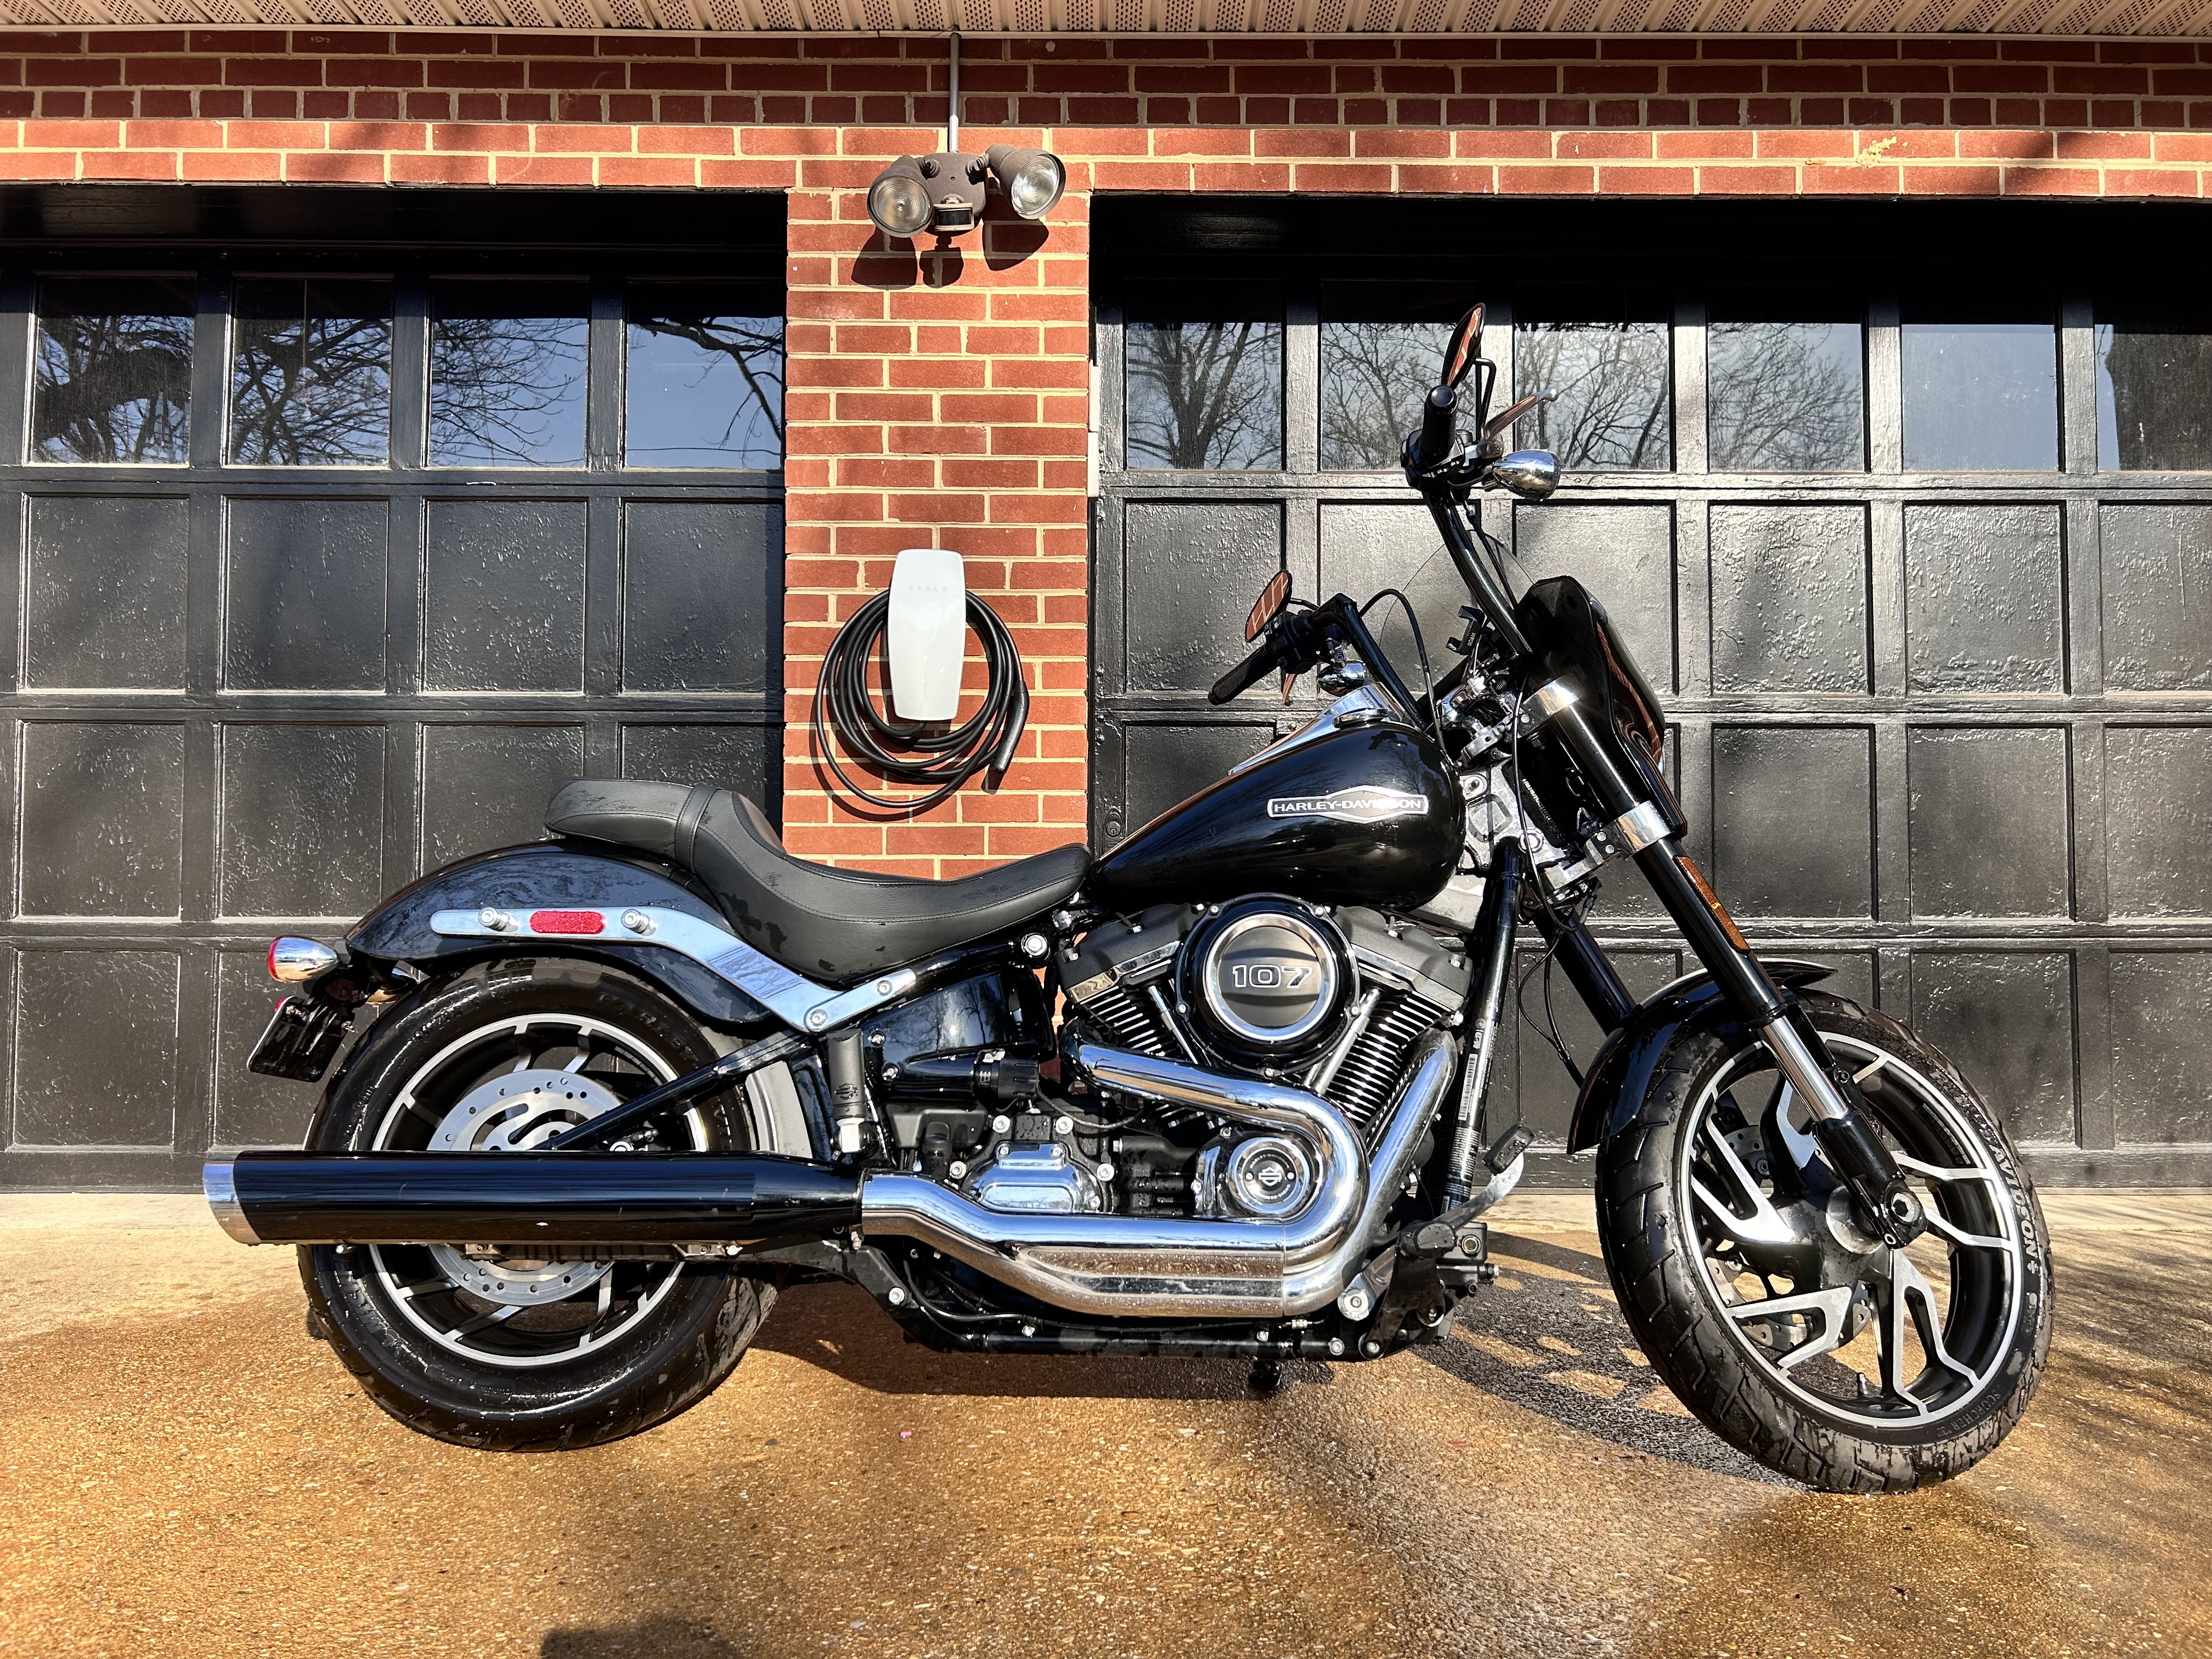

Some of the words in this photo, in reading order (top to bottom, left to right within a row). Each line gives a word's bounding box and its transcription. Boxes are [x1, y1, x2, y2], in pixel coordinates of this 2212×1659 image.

[1468, 632, 1476, 646] ROAM
[1274, 798, 1421, 812] HARLEY-DAVION
[1232, 964, 1313, 988] 107
[1950, 1390, 2001, 1430] SCORCHER
